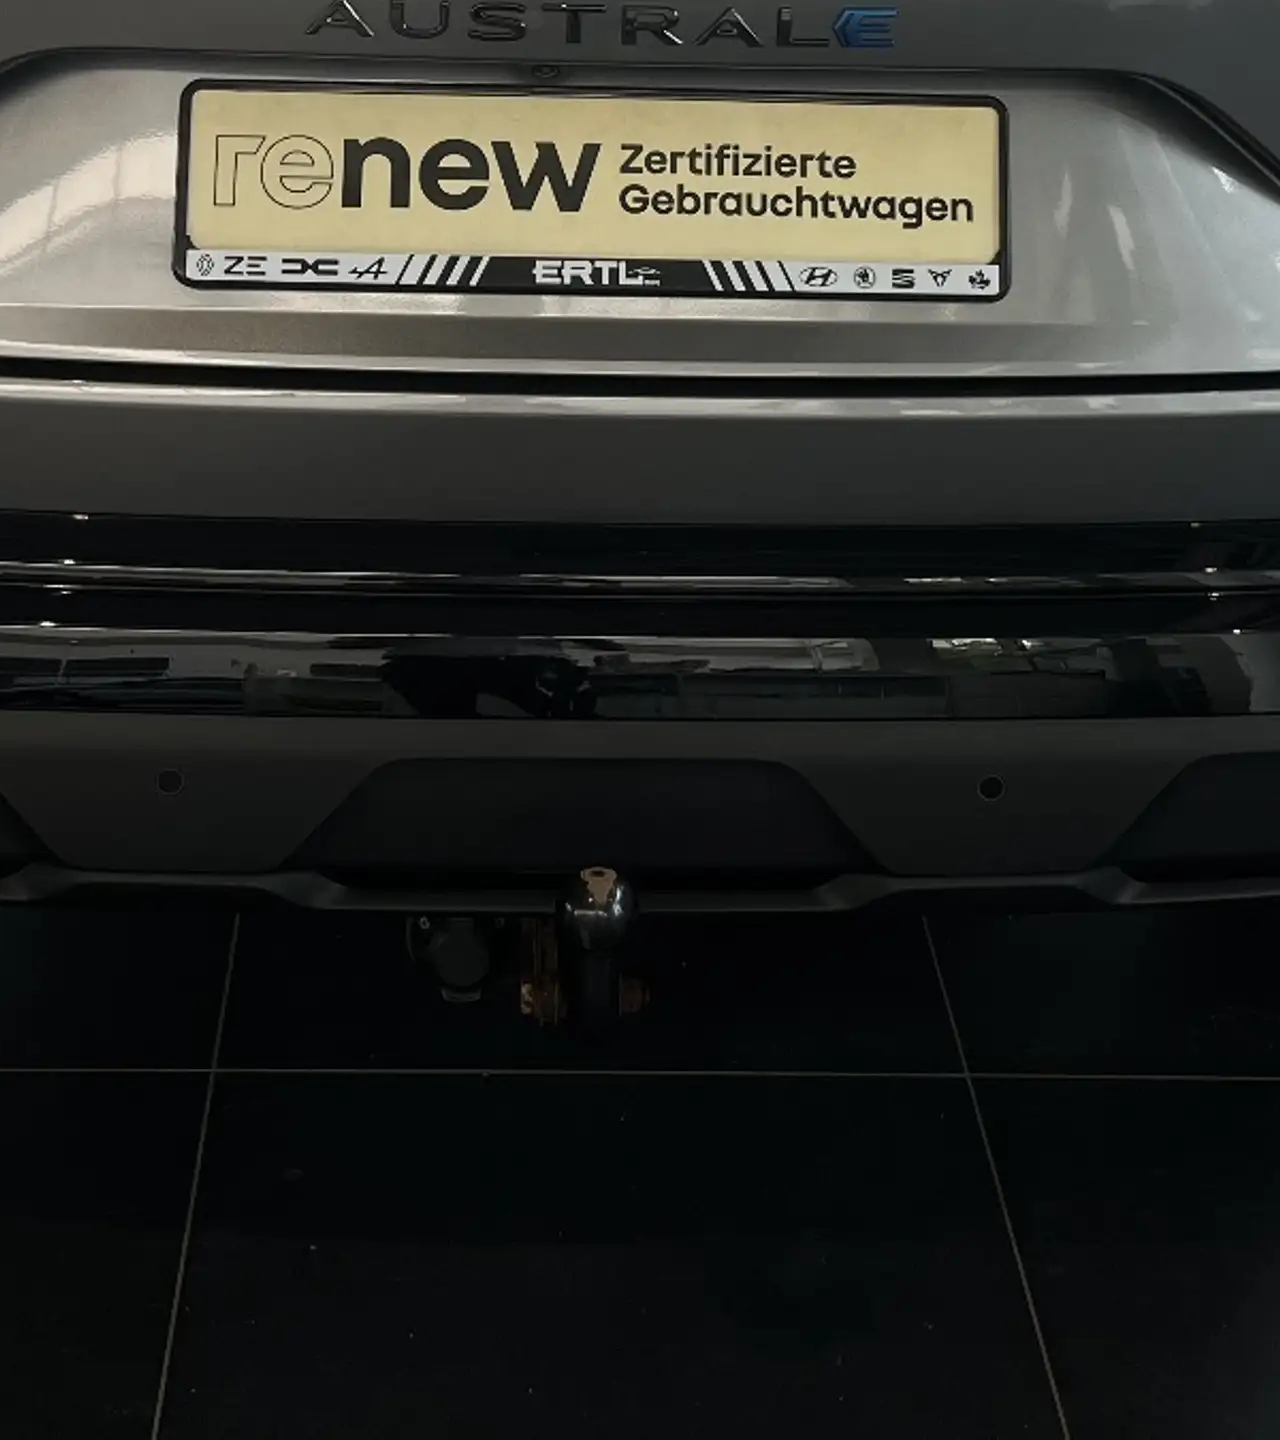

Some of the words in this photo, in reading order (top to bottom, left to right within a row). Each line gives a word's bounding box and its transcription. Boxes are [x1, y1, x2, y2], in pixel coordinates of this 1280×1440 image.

[213, 133, 603, 213] renew
[619, 142, 858, 179] Zertifizierte
[619, 183, 975, 230] Gebrauchtwagen
